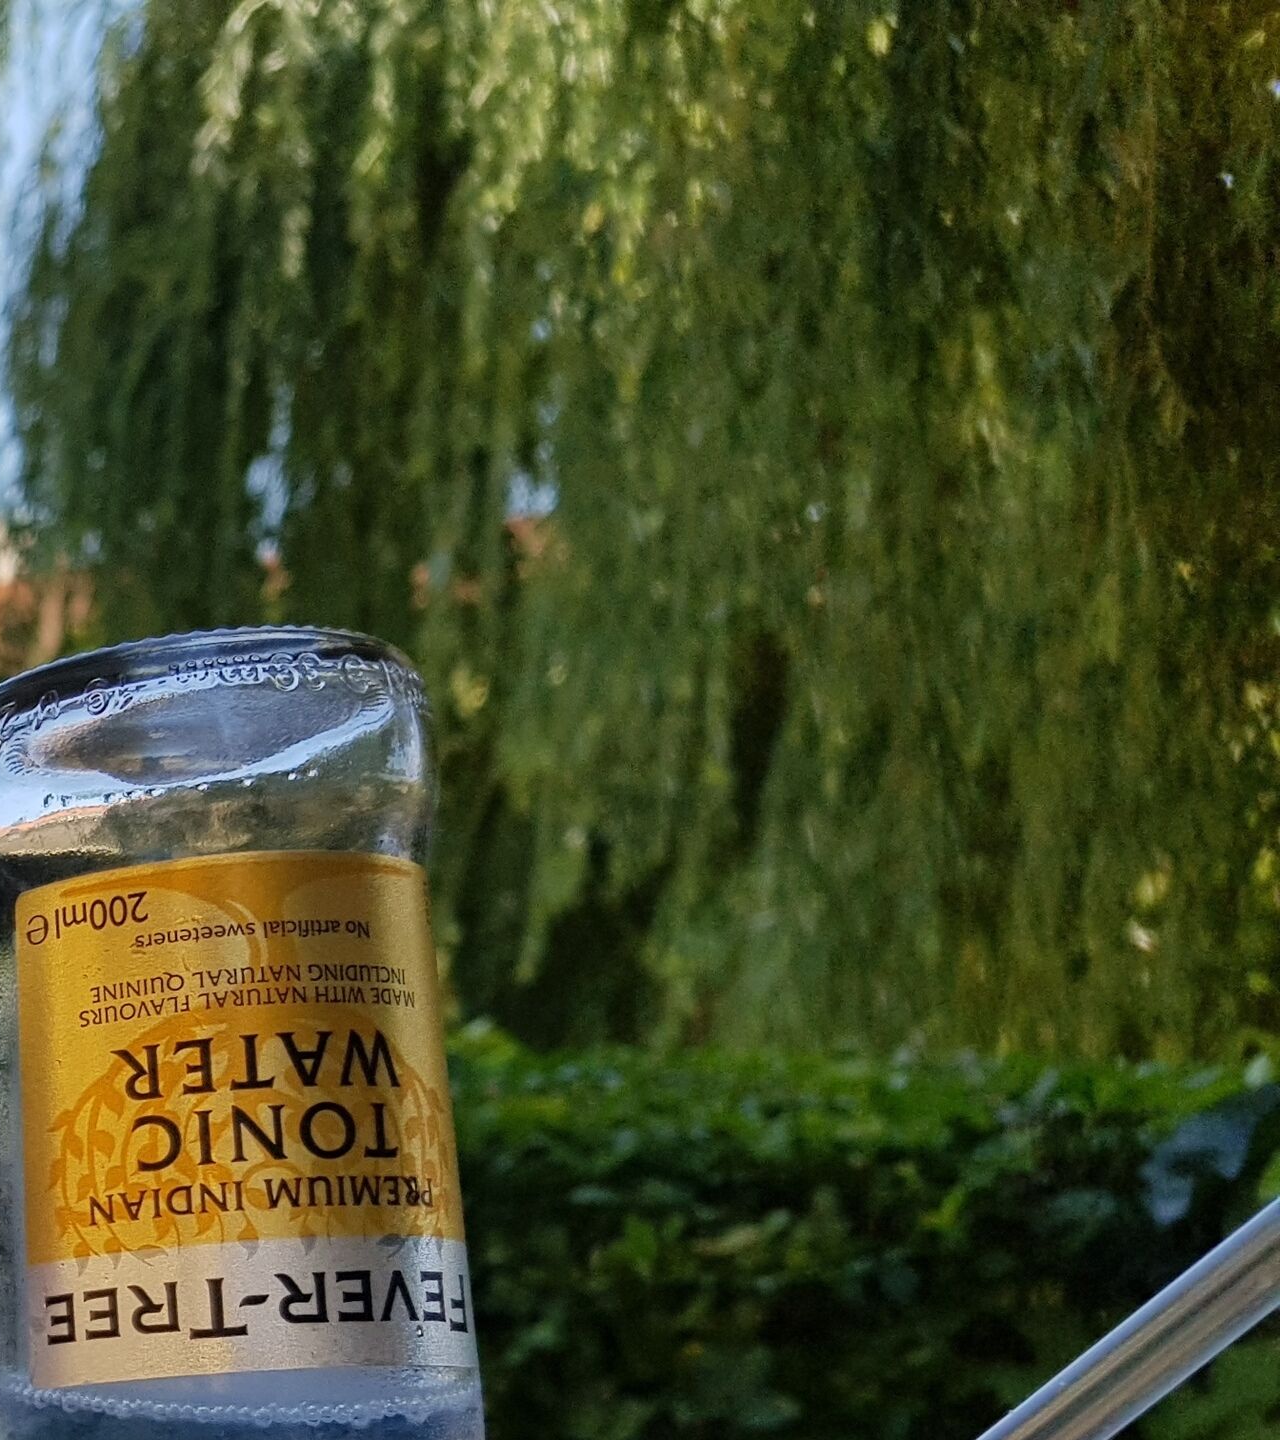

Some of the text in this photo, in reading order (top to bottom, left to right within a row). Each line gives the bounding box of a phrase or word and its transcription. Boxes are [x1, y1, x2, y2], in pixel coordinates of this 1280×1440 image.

[55, 892, 149, 939] 200ml
[134, 920, 369, 949] No artificial sweeteners
[79, 986, 415, 1028] MADE WITH NATURAL FLAVOURS
[90, 964, 406, 1003] INCLUDING NATURAL QUININE
[111, 1029, 400, 1100] WATER
[130, 1102, 398, 1172] TONIC
[87, 1175, 433, 1226] PREMIUM INDIAN
